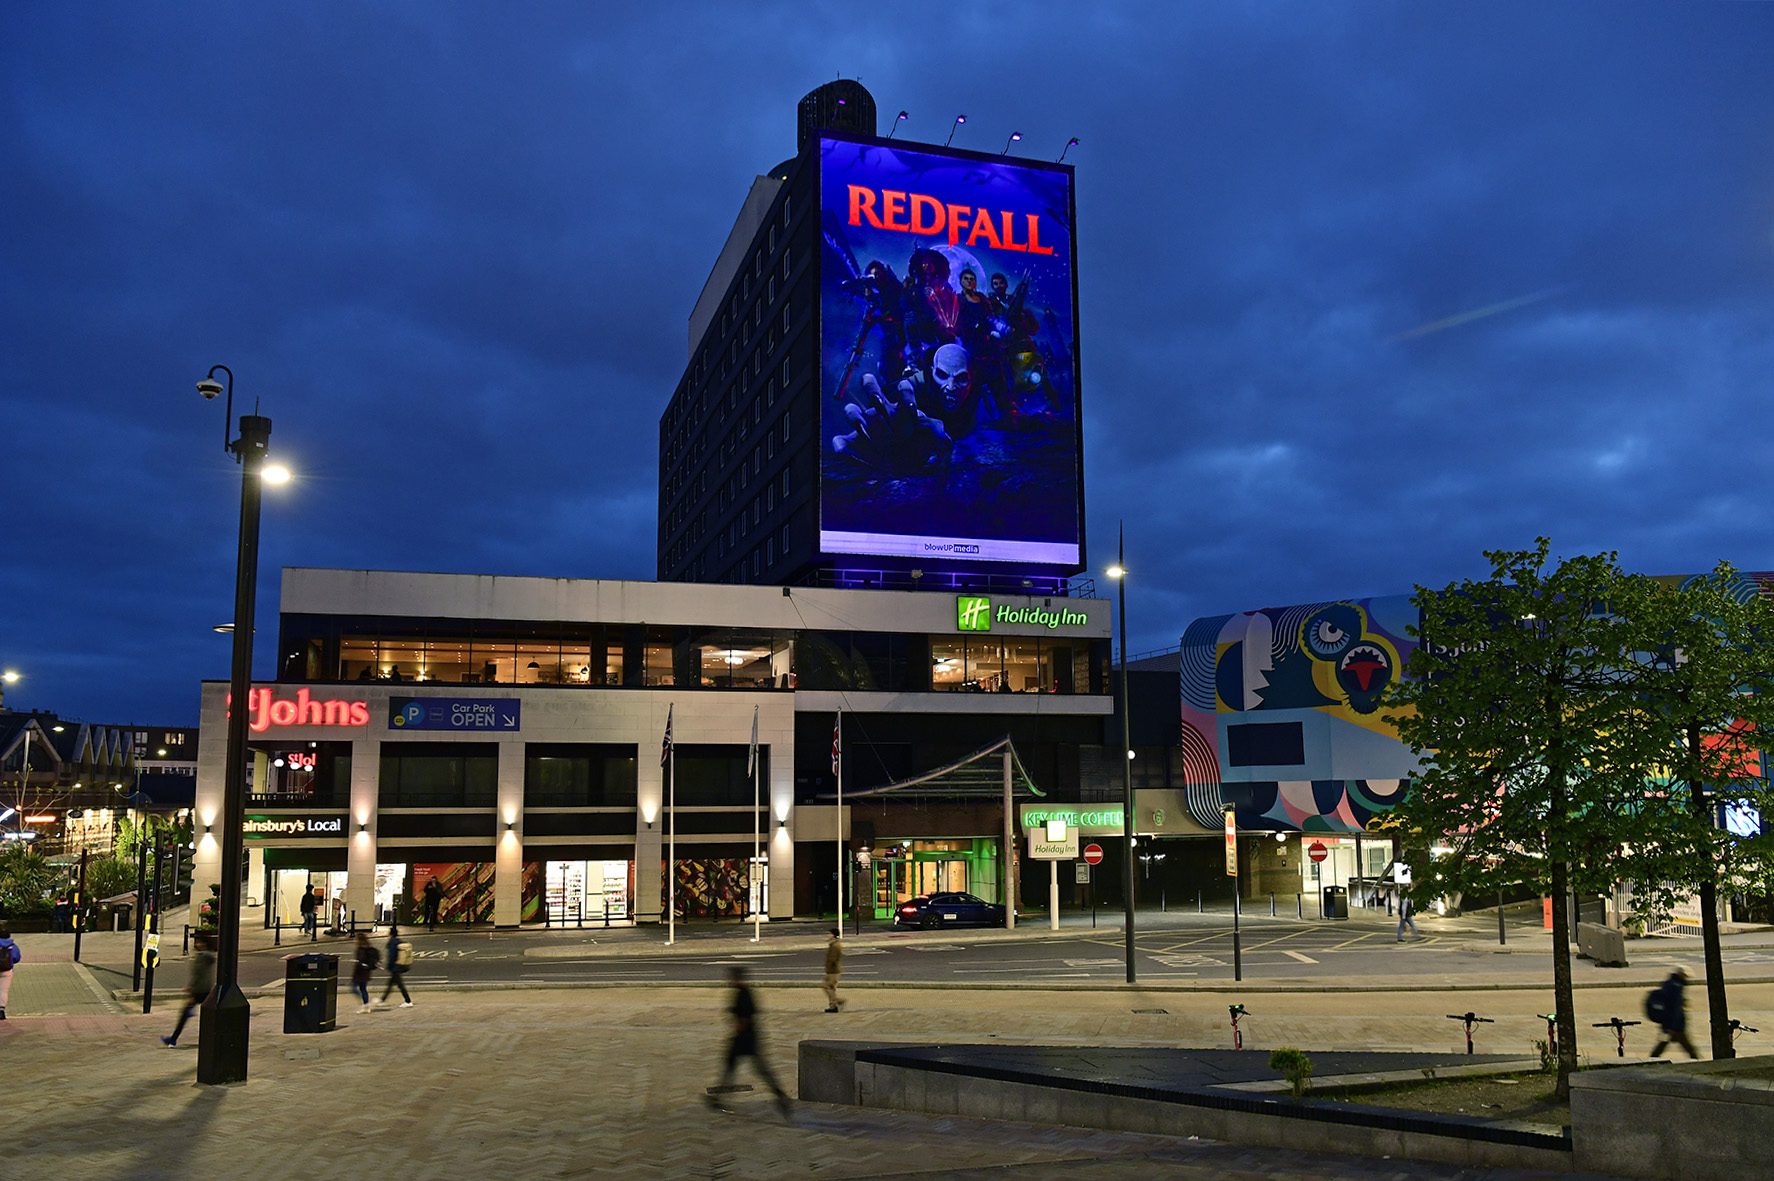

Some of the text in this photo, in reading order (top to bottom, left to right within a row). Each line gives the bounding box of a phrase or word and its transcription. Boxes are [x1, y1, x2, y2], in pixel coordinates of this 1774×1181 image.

[847, 184, 1054, 256] REDFALL
[924, 543, 978, 553] blowUP media
[996, 605, 1087, 629] Holiday Inn
[451, 703, 495, 713] Car Park
[451, 713, 495, 727] OPEN
[243, 818, 341, 834] ainsbury's Local
[1035, 844, 1076, 854] Holiday Inn
